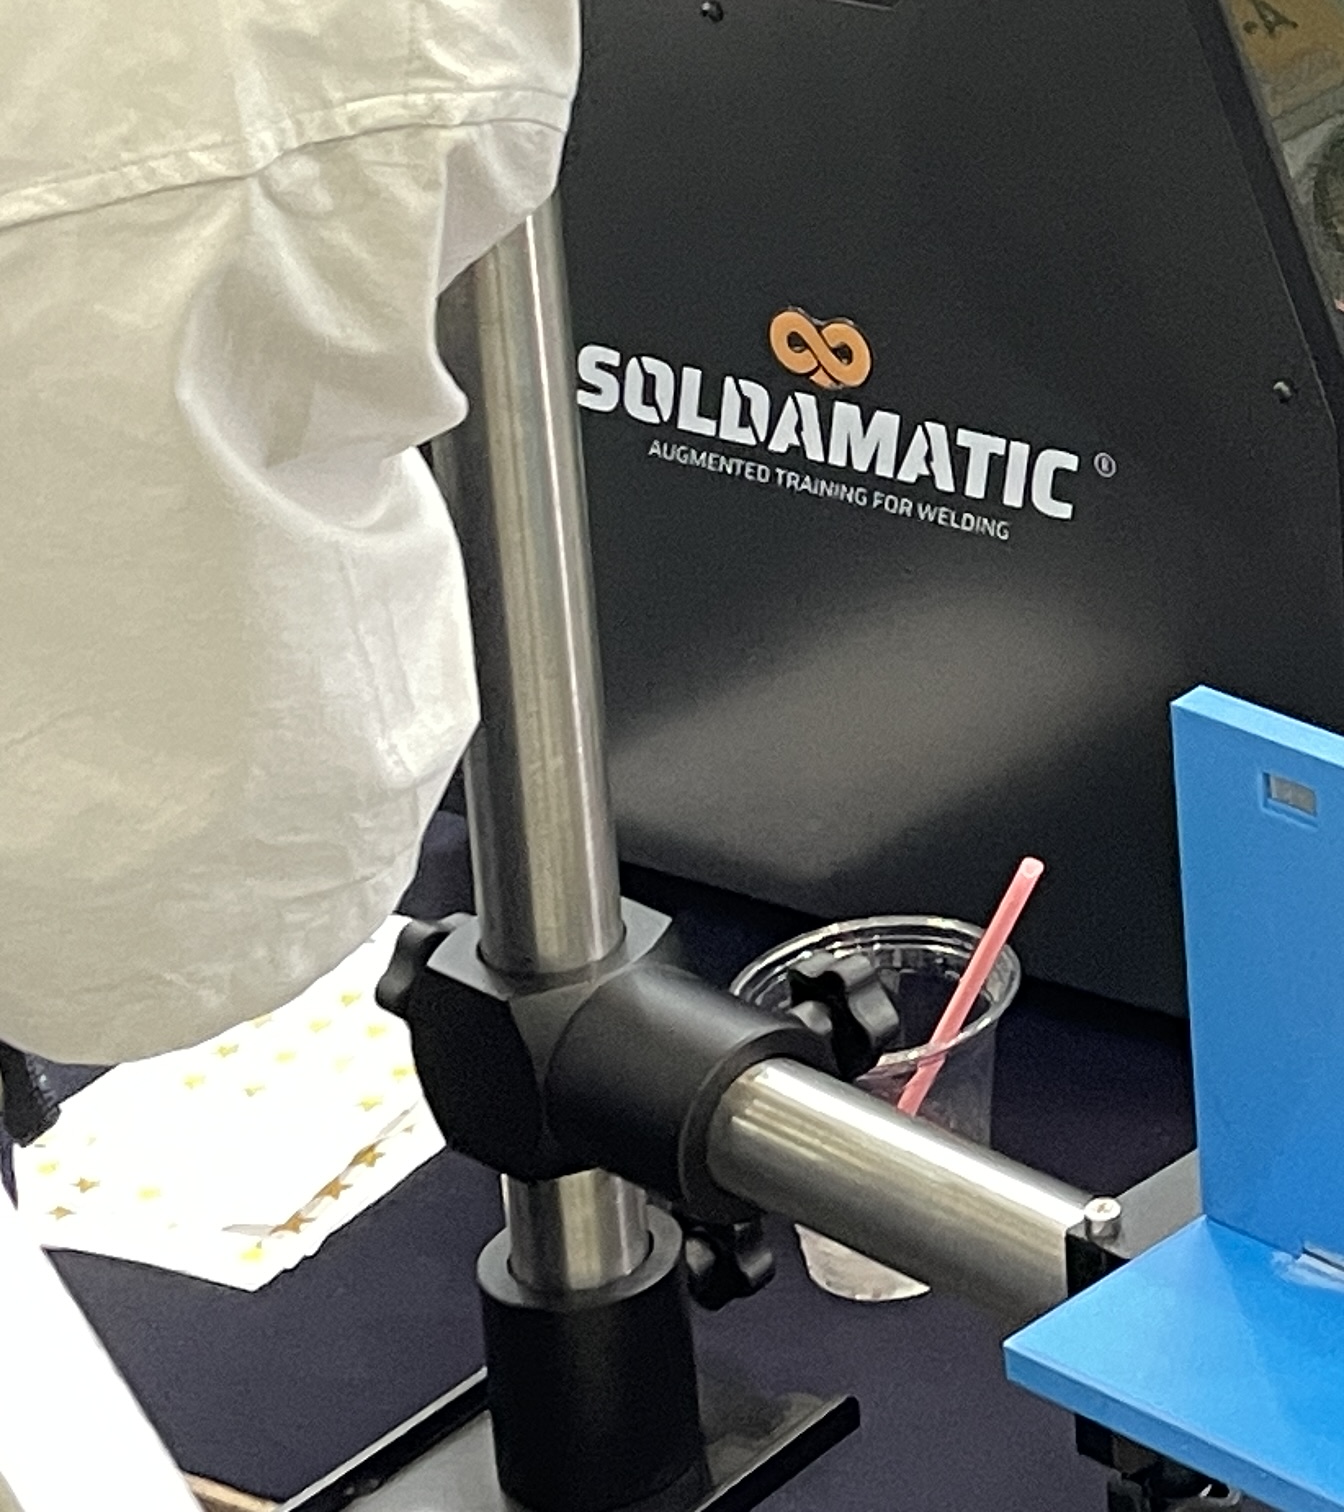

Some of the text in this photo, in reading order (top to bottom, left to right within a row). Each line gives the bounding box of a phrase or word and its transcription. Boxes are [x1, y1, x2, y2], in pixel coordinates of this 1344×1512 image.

[576, 343, 1080, 521] SOLDAMATIC
[647, 439, 1010, 540] AUGMENTED TRAINING FOR WELDING
